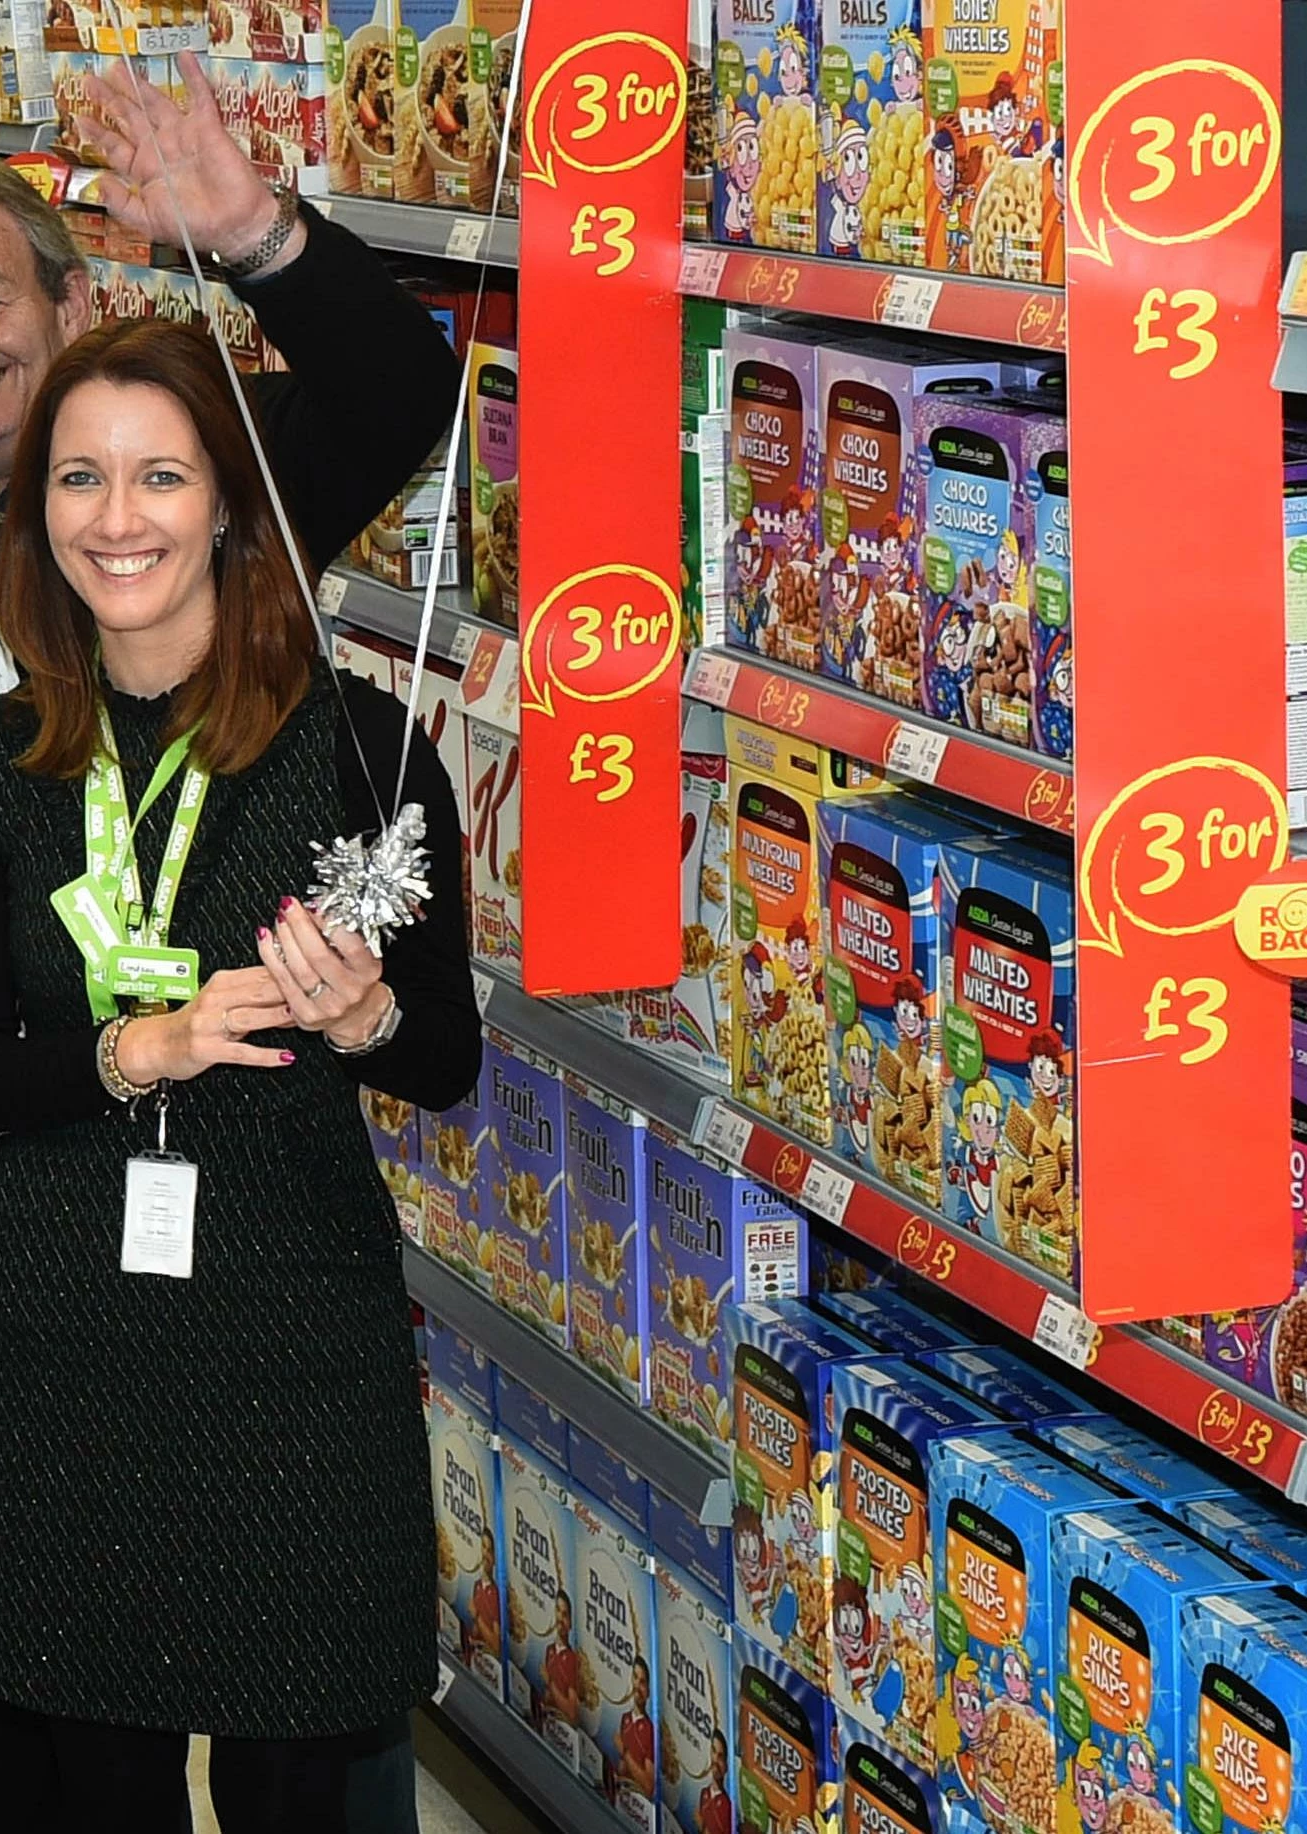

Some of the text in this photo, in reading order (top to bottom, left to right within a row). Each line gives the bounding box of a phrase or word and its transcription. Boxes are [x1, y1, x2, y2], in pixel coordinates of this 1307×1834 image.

[146, 33, 191, 50] 6178
[944, 27, 1010, 54] WHEELIES
[253, 74, 302, 120] Alpen
[571, 72, 677, 140] 3 for
[1129, 112, 1266, 203] 3 for
[569, 205, 638, 276] £3
[106, 272, 146, 318] Alpen
[777, 264, 799, 303] £3
[1132, 287, 1219, 380] £3
[744, 410, 782, 438] CHOCO
[840, 433, 879, 462] CHOCO
[738, 434, 790, 467] WHEELIES
[834, 458, 888, 493] WHEELIES
[942, 479, 987, 505] CHOCO
[934, 503, 998, 537] SQUARES
[566, 604, 669, 670] 3 for
[787, 692, 810, 726] £3
[470, 725, 502, 754] Special
[568, 732, 635, 802] £3
[741, 829, 802, 872] MULTIGRAIN
[745, 857, 796, 895] WHEELIES
[1139, 807, 1275, 895] 3 for
[841, 895, 892, 939] MALTED
[837, 922, 901, 973] WHEATIES
[969, 945, 1030, 990] MALTED
[963, 971, 1038, 1026] WHEATIES
[1143, 976, 1229, 1065] £3
[492, 1066, 536, 1126] Fruit
[568, 1108, 610, 1174] Fruit
[652, 1158, 704, 1227] Fruit
[747, 1232, 795, 1247] FREE
[902, 1226, 915, 1249] 3
[933, 1237, 957, 1280] £3
[742, 1392, 797, 1443] FROSTED
[1204, 1400, 1273, 1465] 3 for £3
[748, 1424, 793, 1467] FLAKES
[445, 1450, 476, 1499] Bran
[849, 1458, 912, 1516] FROSTED
[442, 1482, 484, 1537] Flakes
[515, 1506, 550, 1561] Bran
[856, 1491, 905, 1540] FLAKES
[512, 1538, 556, 1599] Flakes
[964, 1551, 998, 1590] RICE
[589, 1567, 626, 1626] Bran
[958, 1575, 1007, 1620] SNAPS
[585, 1600, 635, 1666] Flakes
[1088, 1631, 1121, 1676] RICE
[669, 1636, 706, 1697] Bran
[1081, 1655, 1131, 1707] SNAPS
[666, 1668, 714, 1740] Flakes
[748, 1712, 804, 1771] FROSTED
[1221, 1723, 1259, 1769] RICE
[754, 1742, 798, 1794] FLAKES
[1213, 1746, 1267, 1803] SNAPS
